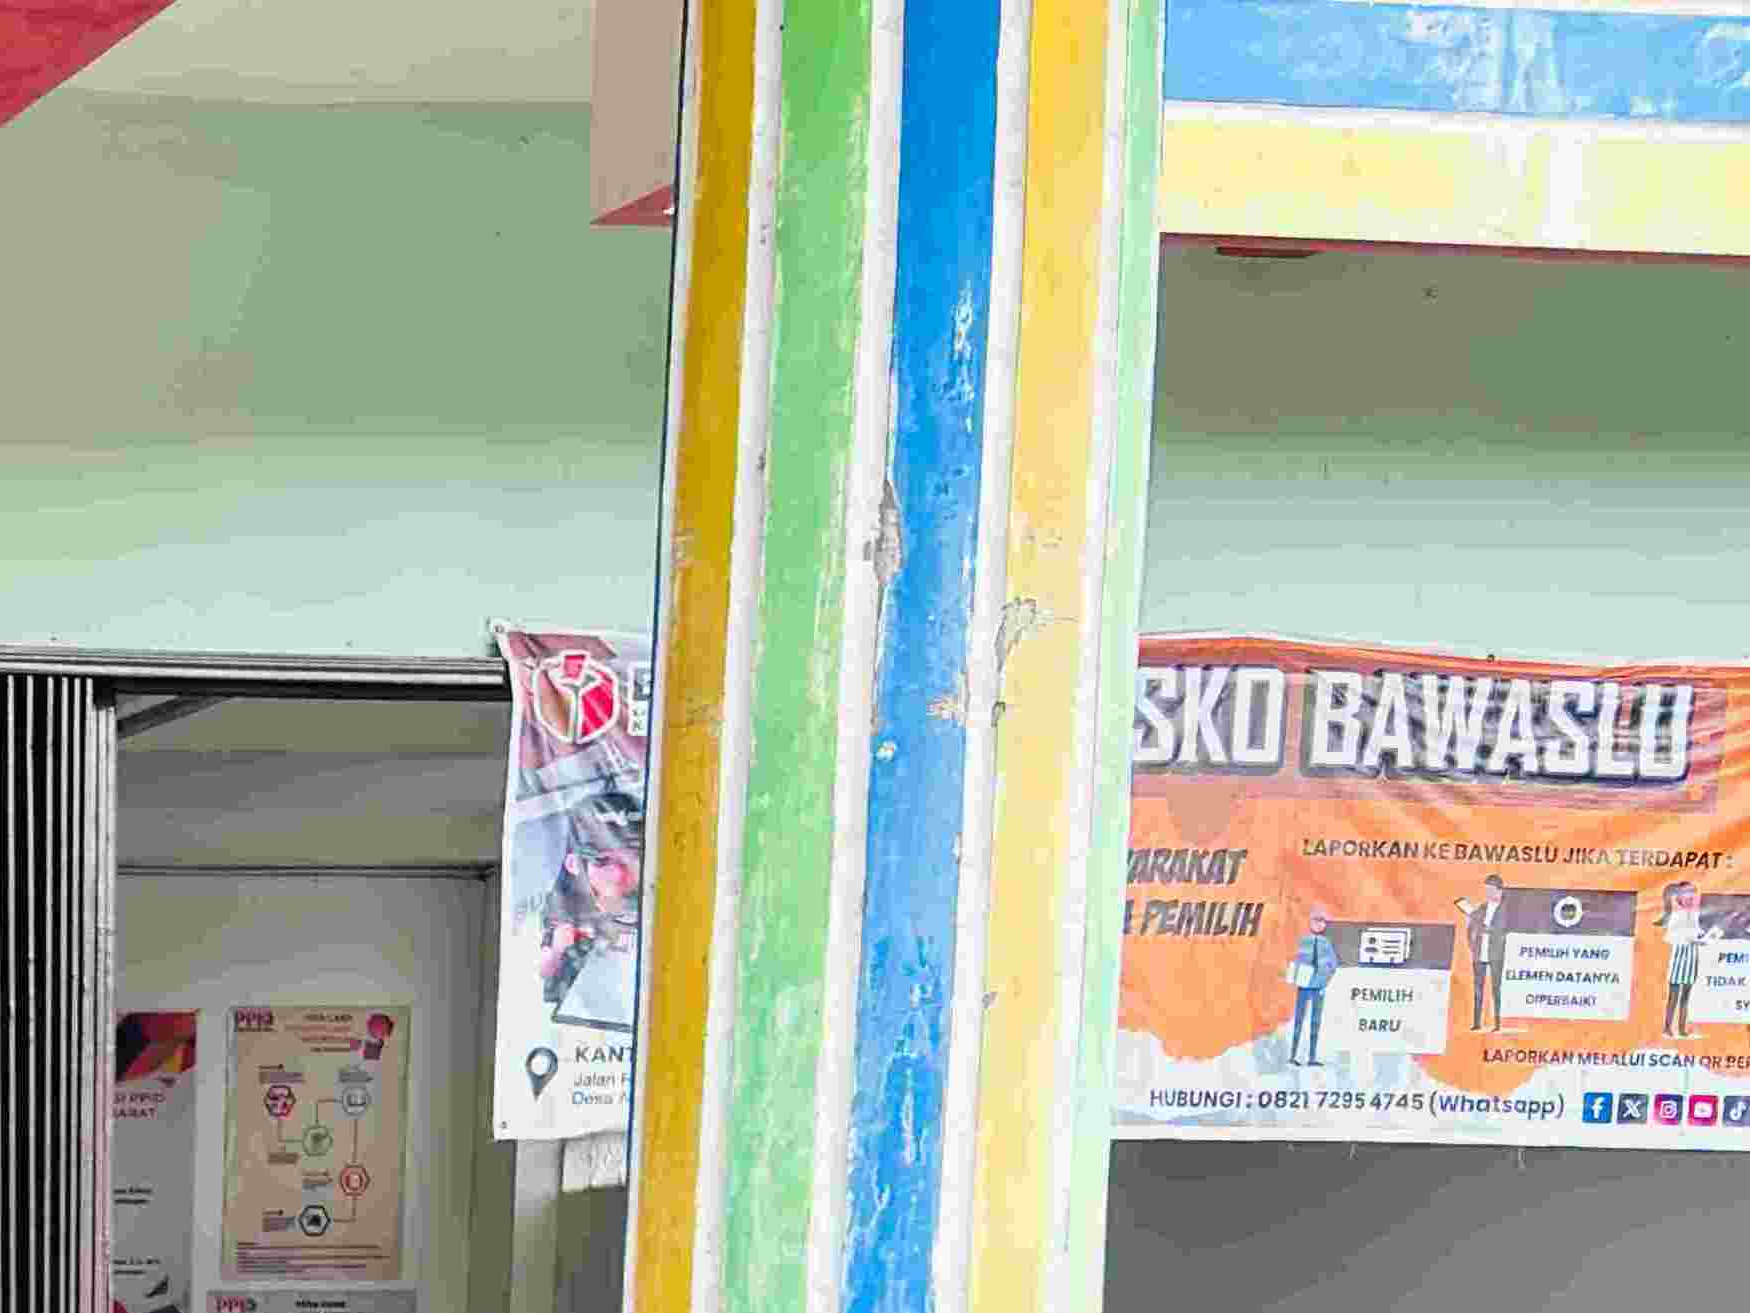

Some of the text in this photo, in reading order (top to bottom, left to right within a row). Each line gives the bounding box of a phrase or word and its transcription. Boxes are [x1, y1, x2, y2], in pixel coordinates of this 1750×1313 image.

[1310, 669, 1696, 779] BAWASLU
[1302, 838, 1419, 859] LAPORKAN
[1423, 841, 1450, 860] KE
[1454, 844, 1559, 864] BAWASLU
[1561, 847, 1612, 866] JIKA
[1614, 848, 1722, 869] TERDAPAT
[1140, 898, 1264, 936] PEMILIH
[1505, 969, 1620, 985] ELEMEN DATANYA
[1350, 987, 1414, 1003] PEMILIH
[1357, 1018, 1402, 1032] BARU
[1482, 1048, 1575, 1065] LAPORKAN
[1576, 1051, 1645, 1066] MELALUI
[1648, 1052, 1695, 1067] SCAN
[1149, 1088, 1241, 1109] HUBUNGI
[1257, 1090, 1309, 1110] 0821
[1315, 1091, 1366, 1111] 7295
[1369, 1092, 1425, 1112] 4745
[1428, 1090, 1566, 1120] (Whatsapp)
